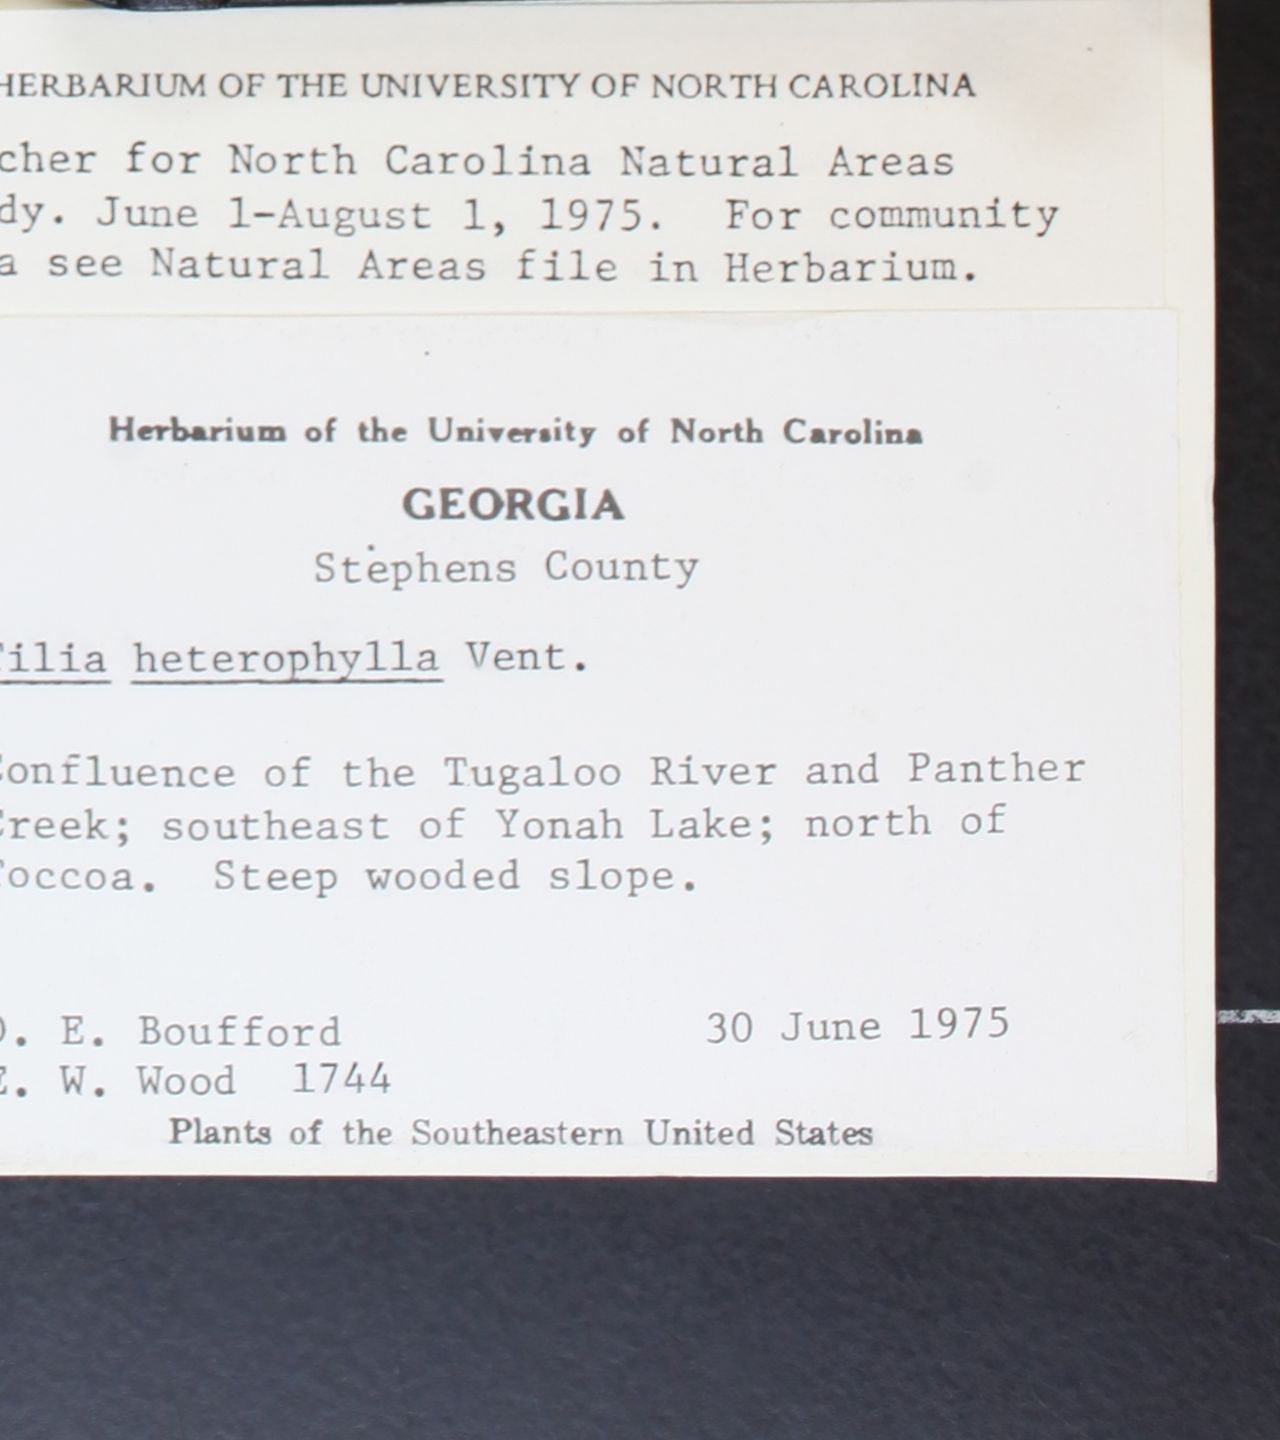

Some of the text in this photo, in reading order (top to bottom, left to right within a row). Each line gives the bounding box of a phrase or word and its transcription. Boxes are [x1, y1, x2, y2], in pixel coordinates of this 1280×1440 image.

[218, 72, 265, 98] OF
[276, 72, 348, 99] THE
[361, 72, 581, 99] UNIVERSITY
[591, 73, 640, 99] OF
[652, 73, 777, 99] NORTH
[788, 72, 977, 99] CAROLINA
[127, 140, 201, 174] for
[228, 143, 357, 175] North
[385, 143, 591, 176] Carolina
[620, 144, 799, 178] Natural
[828, 145, 954, 177] Areas
[97, 195, 198, 228] June
[230, 196, 431, 238] 1-August
[464, 198, 505, 238] 1,
[541, 197, 660, 232] 1975.
[725, 198, 802, 231] For
[830, 196, 1059, 238] community
[49, 254, 122, 277] see
[150, 247, 329, 281] Natural
[358, 249, 486, 281] Areas
[517, 248, 617, 282] file
[650, 251, 698, 283] in
[724, 250, 976, 284] Herbarium.
[109, 415, 924, 449] Herbarium of the University of North Carolina
[402, 486, 626, 522] GEORGIA
[315, 549, 699, 592] Stephens County
[130, 639, 445, 686] heterophylla
[465, 641, 586, 672] Vent.
[265, 755, 311, 787] of
[343, 756, 415, 788] the
[444, 755, 621, 796] Tugaloo
[651, 754, 777, 786] River
[806, 752, 879, 785] and
[908, 751, 1086, 783] Panther
[163, 809, 389, 841] southeast
[420, 807, 466, 839] of
[495, 808, 624, 840] Yonah
[650, 806, 772, 845] Lake;
[805, 804, 932, 837] north
[961, 802, 1007, 835] of
[215, 859, 338, 899] Steep
[365, 858, 520, 891] wooded
[550, 858, 695, 898] slope.
[61, 1015, 103, 1047] E.
[138, 1015, 341, 1047] Boufford
[707, 1006, 1009, 1044] 30 June 1975
[59, 1065, 105, 1098] W.
[136, 1064, 236, 1096] Wood
[293, 1061, 391, 1094] 1744
[169, 1117, 874, 1146] Plants of the Southeastern United States
